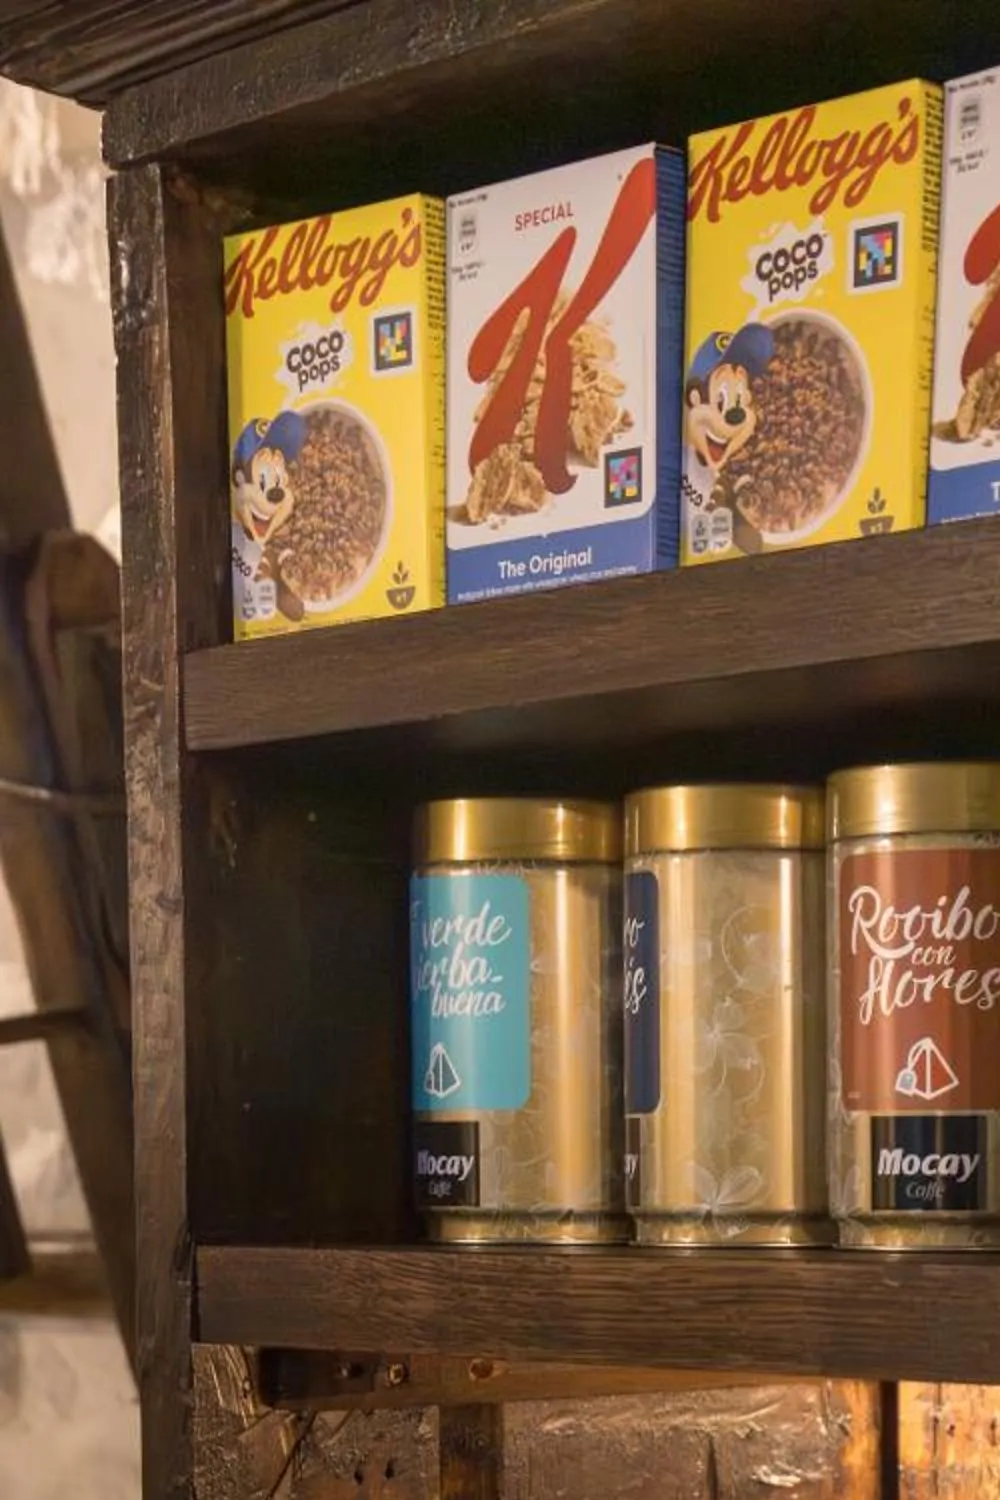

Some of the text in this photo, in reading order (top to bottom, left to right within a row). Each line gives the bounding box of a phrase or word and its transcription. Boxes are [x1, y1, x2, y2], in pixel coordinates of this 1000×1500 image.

[686, 97, 919, 223] Kellogg's
[514, 201, 574, 232] SPECIAL
[225, 207, 421, 318] Kellogg's
[498, 547, 592, 580] The Original
[910, 945, 956, 966] con
[877, 1148, 981, 1184] Mocay
